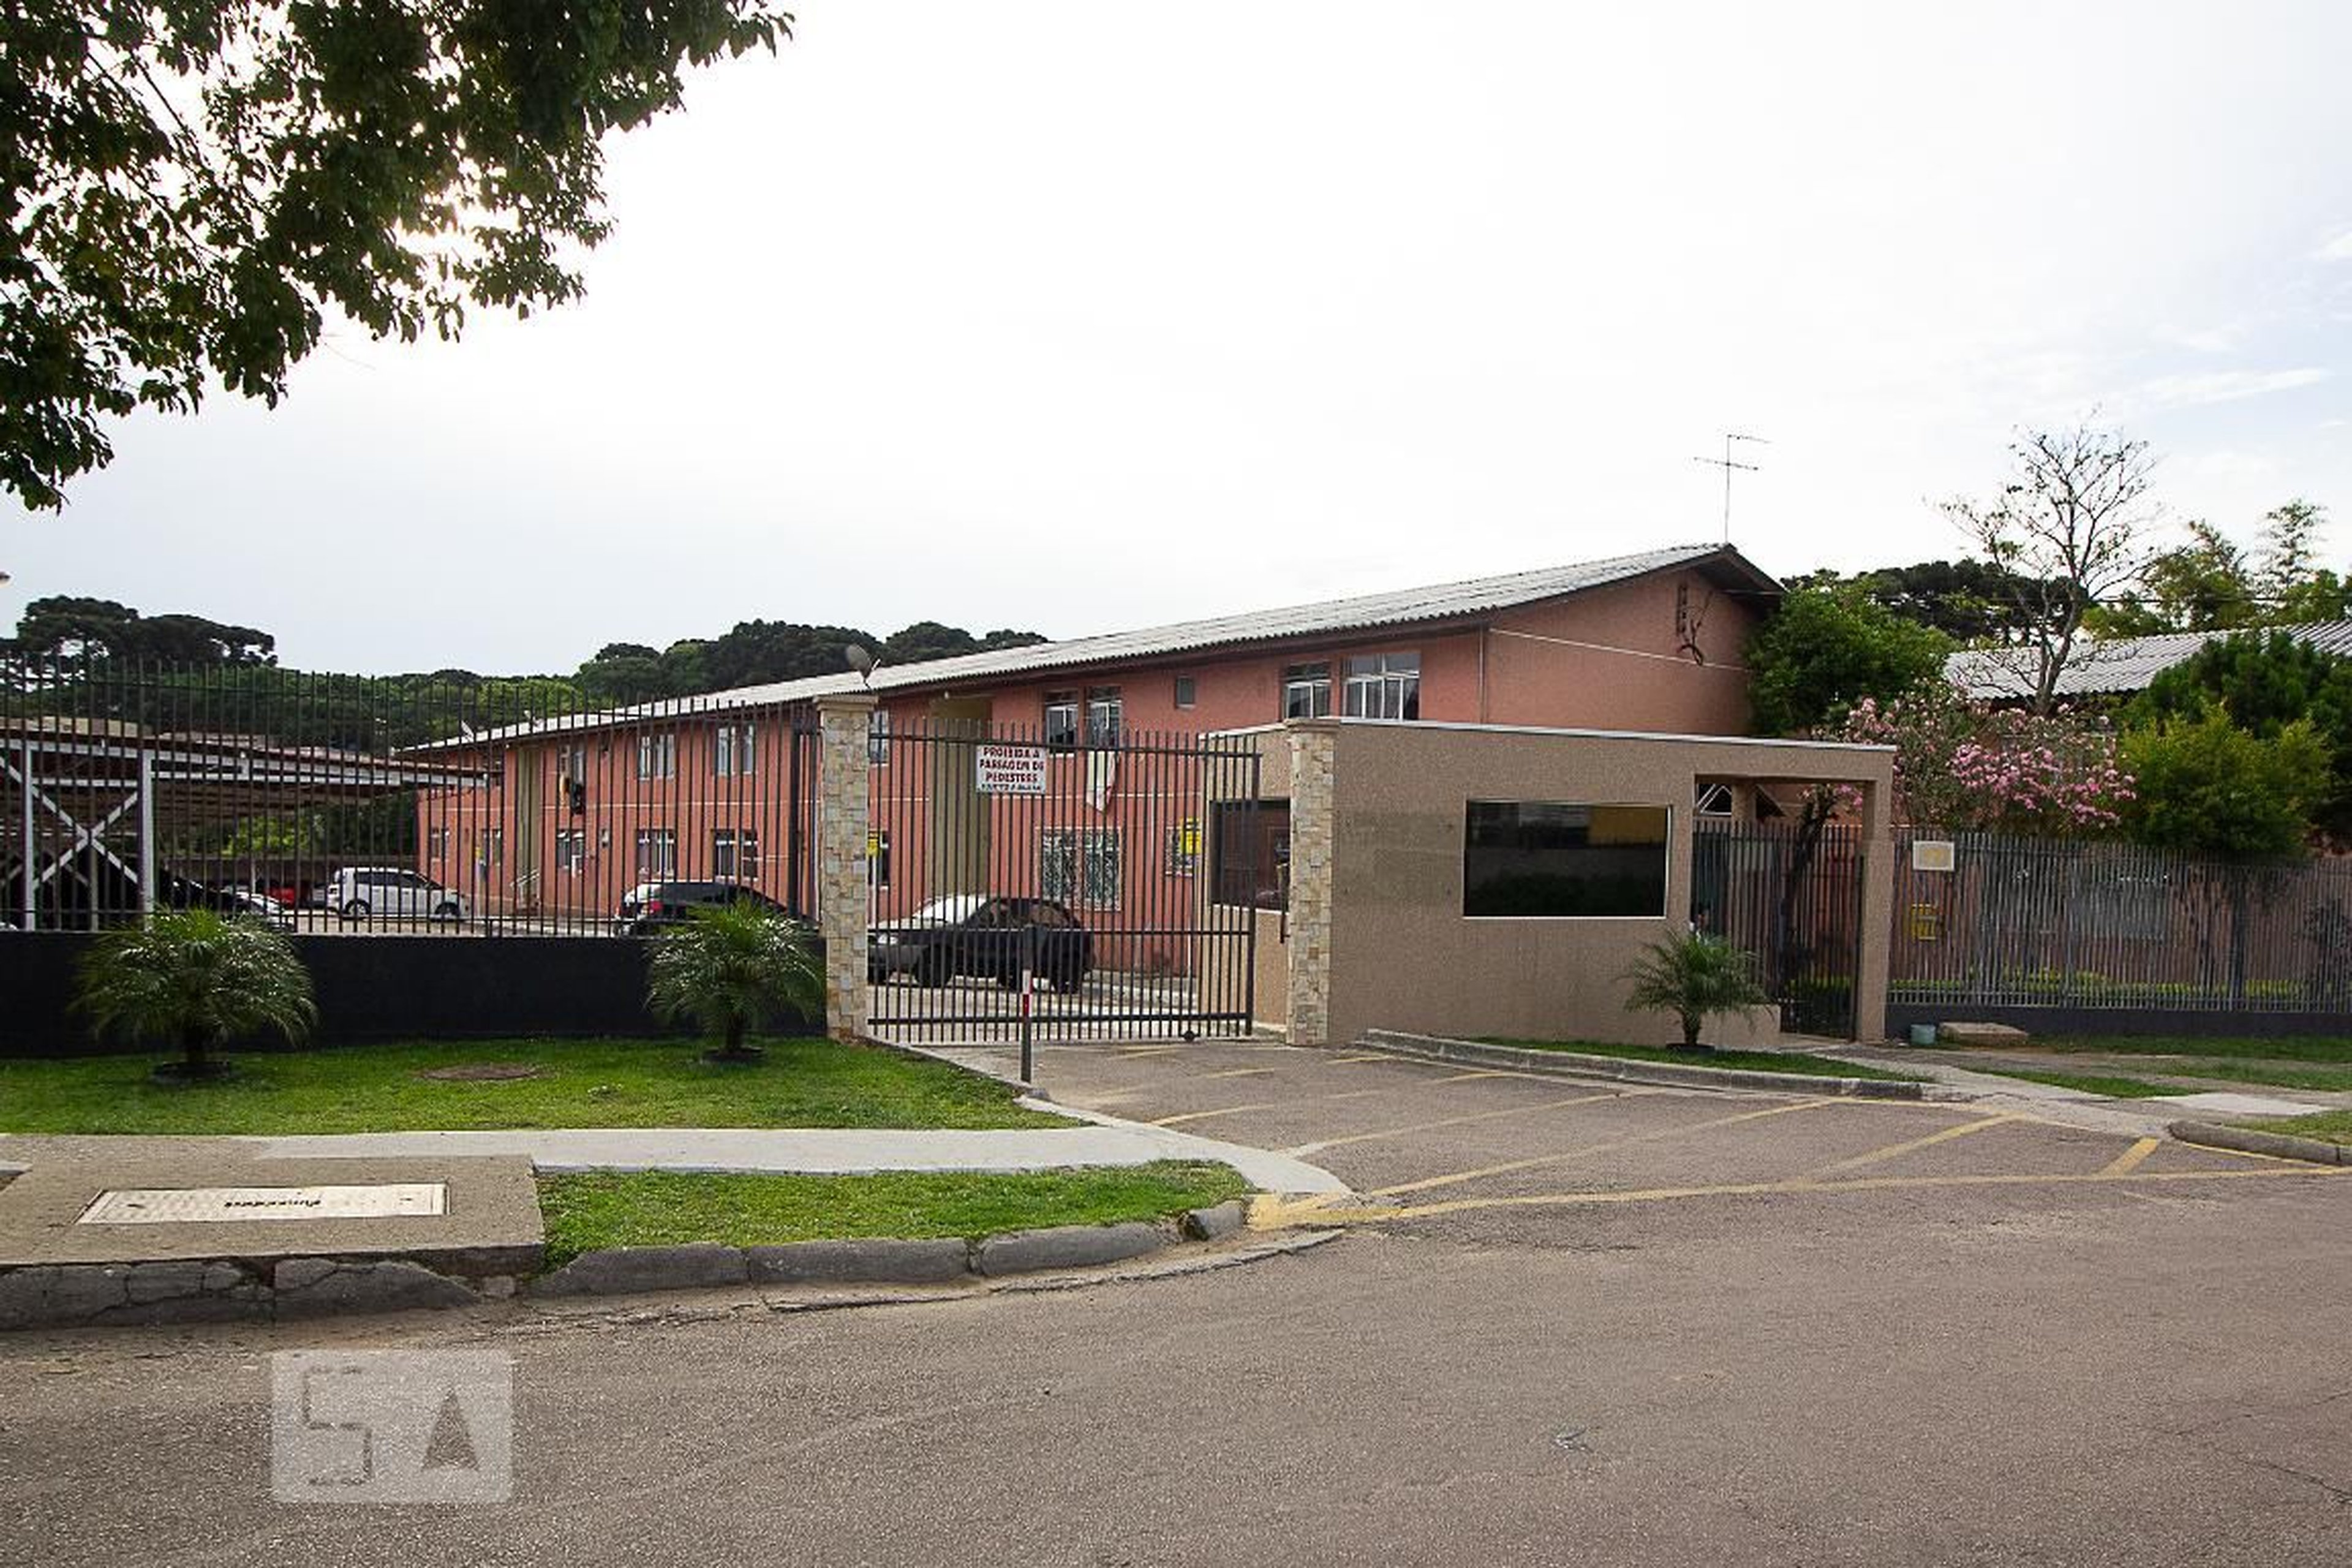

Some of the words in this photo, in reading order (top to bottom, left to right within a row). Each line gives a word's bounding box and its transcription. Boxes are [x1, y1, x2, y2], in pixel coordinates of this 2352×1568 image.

[984, 747, 1031, 758] PROIBIDA
[1033, 748, 1040, 758] A
[979, 759, 1030, 771] PASSAGEM
